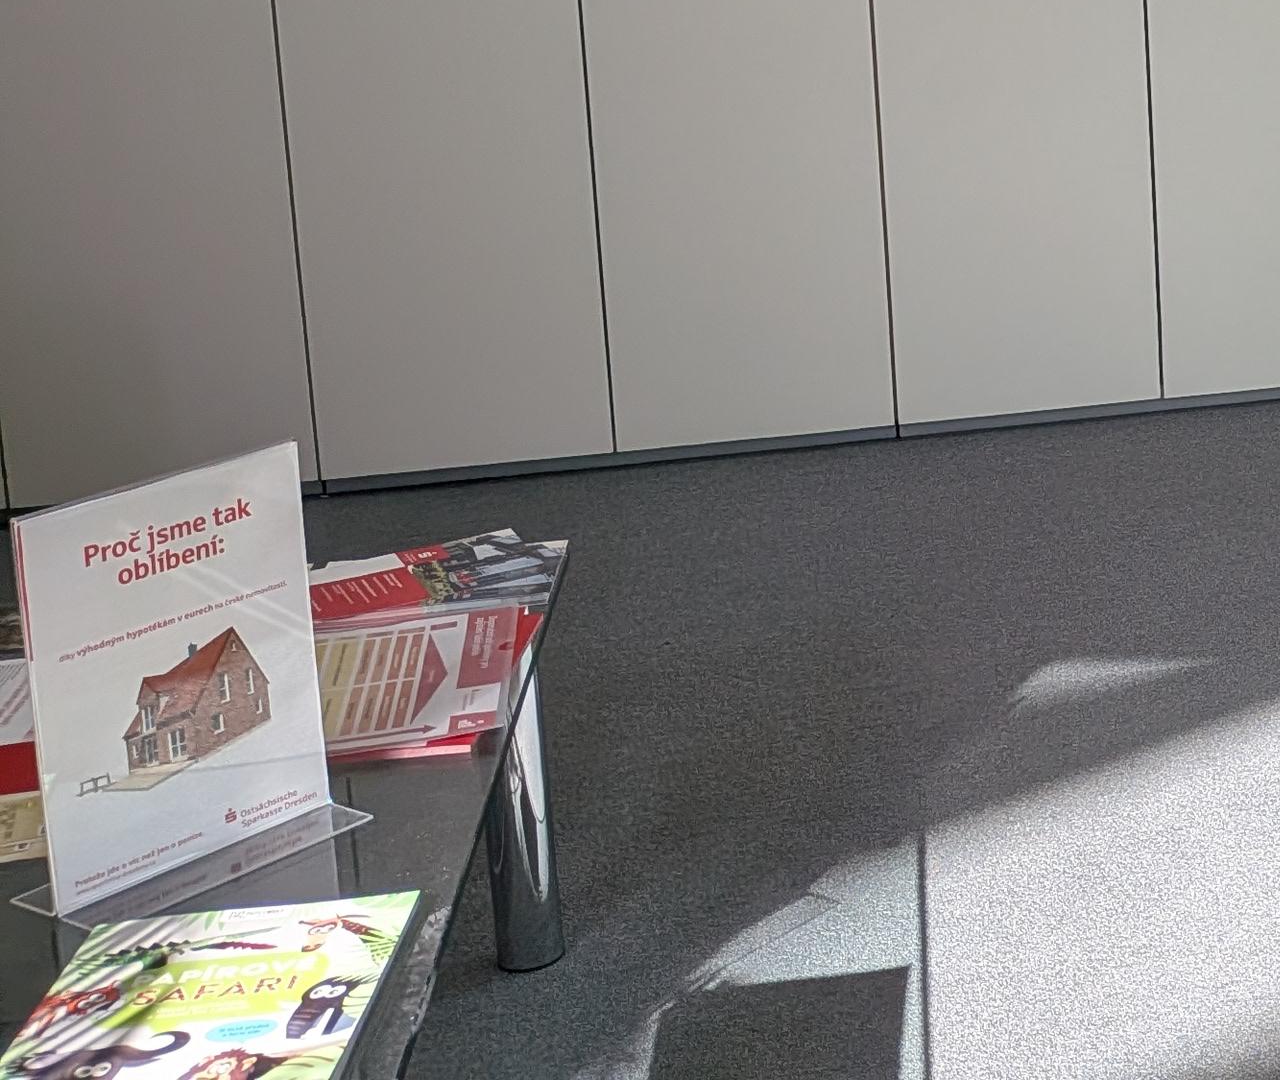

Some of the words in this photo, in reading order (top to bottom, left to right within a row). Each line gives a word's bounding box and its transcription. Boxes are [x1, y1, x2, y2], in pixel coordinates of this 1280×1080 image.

[83, 530, 141, 568] Proč
[146, 515, 206, 555] jsme
[212, 498, 252, 526] tak
[118, 534, 225, 585] oblíbení:
[76, 636, 125, 657] výhodným
[126, 617, 176, 641] hypotékám
[184, 604, 214, 620] eurech
[240, 789, 298, 818] Ostsächsische
[241, 805, 284, 828] Sparkasse
[285, 791, 318, 811] Dresden
[132, 975, 298, 1006] SAFARI
